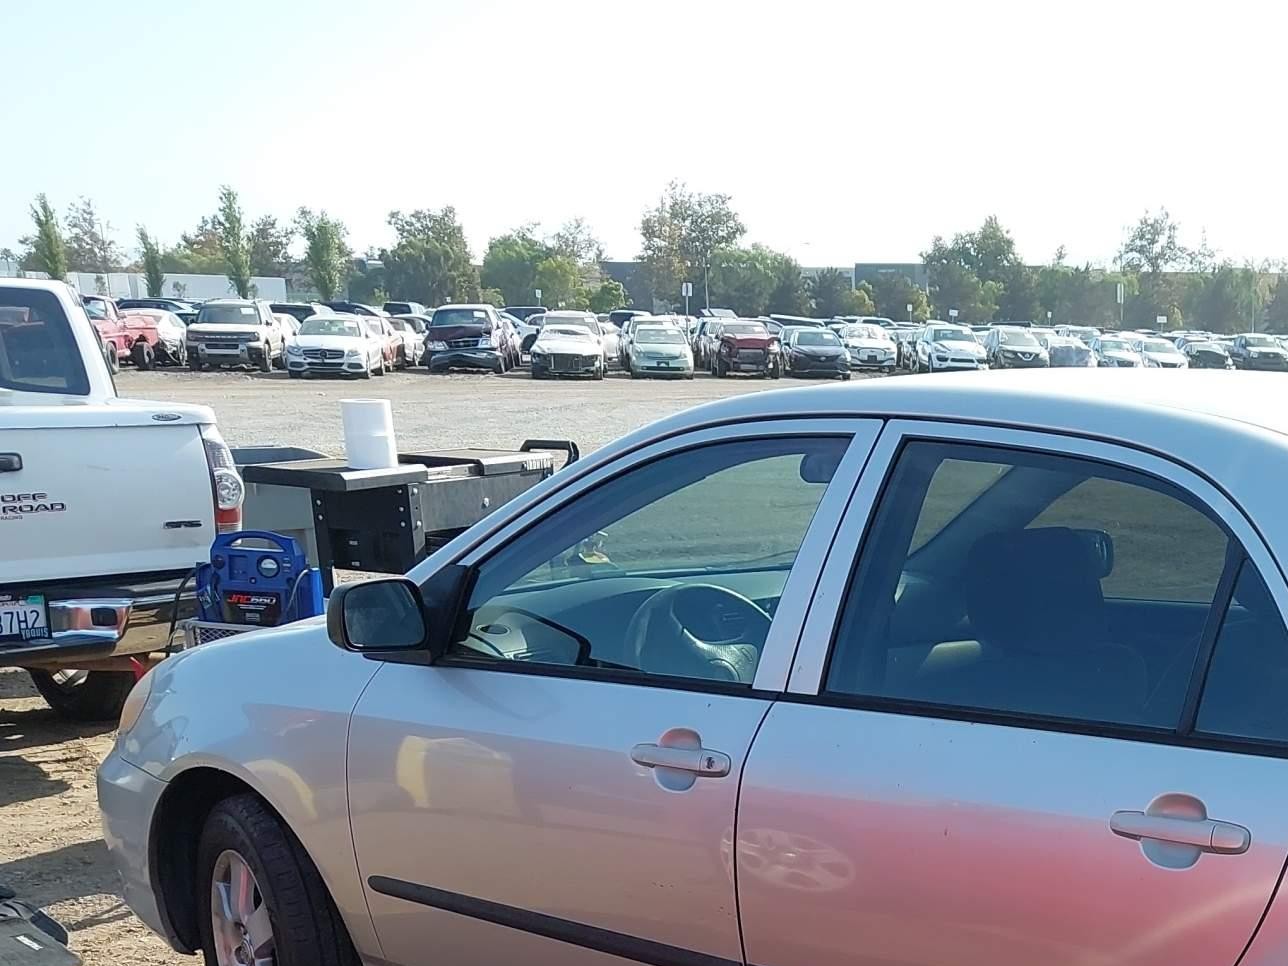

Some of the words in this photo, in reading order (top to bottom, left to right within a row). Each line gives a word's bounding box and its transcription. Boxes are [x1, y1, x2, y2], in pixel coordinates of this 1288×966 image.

[0, 493, 48, 503] OFF
[2, 503, 66, 514] ROAD
[227, 594, 276, 605] JNC660
